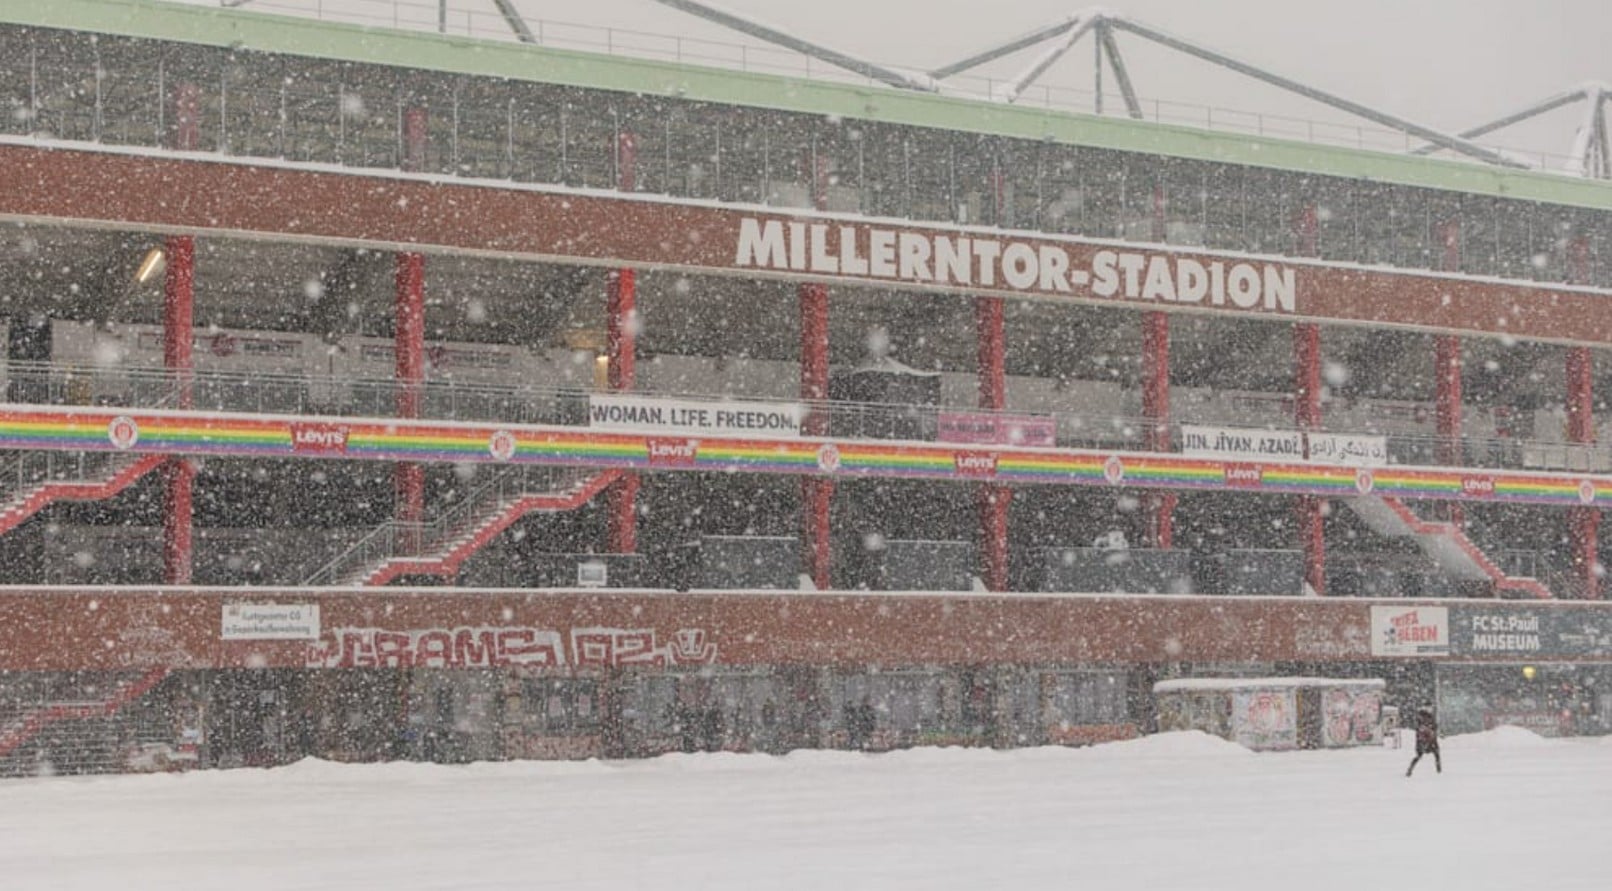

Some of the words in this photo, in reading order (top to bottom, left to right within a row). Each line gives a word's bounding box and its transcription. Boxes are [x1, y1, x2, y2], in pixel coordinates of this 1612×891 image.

[735, 217, 1296, 312] MILLERNTOR-STADION
[591, 404, 667, 425] WOMAN.
[671, 408, 712, 427] LIFE.
[716, 410, 798, 430] FREEDOM.
[1472, 615, 1489, 631] FC
[1473, 633, 1541, 650] MUSEUM
